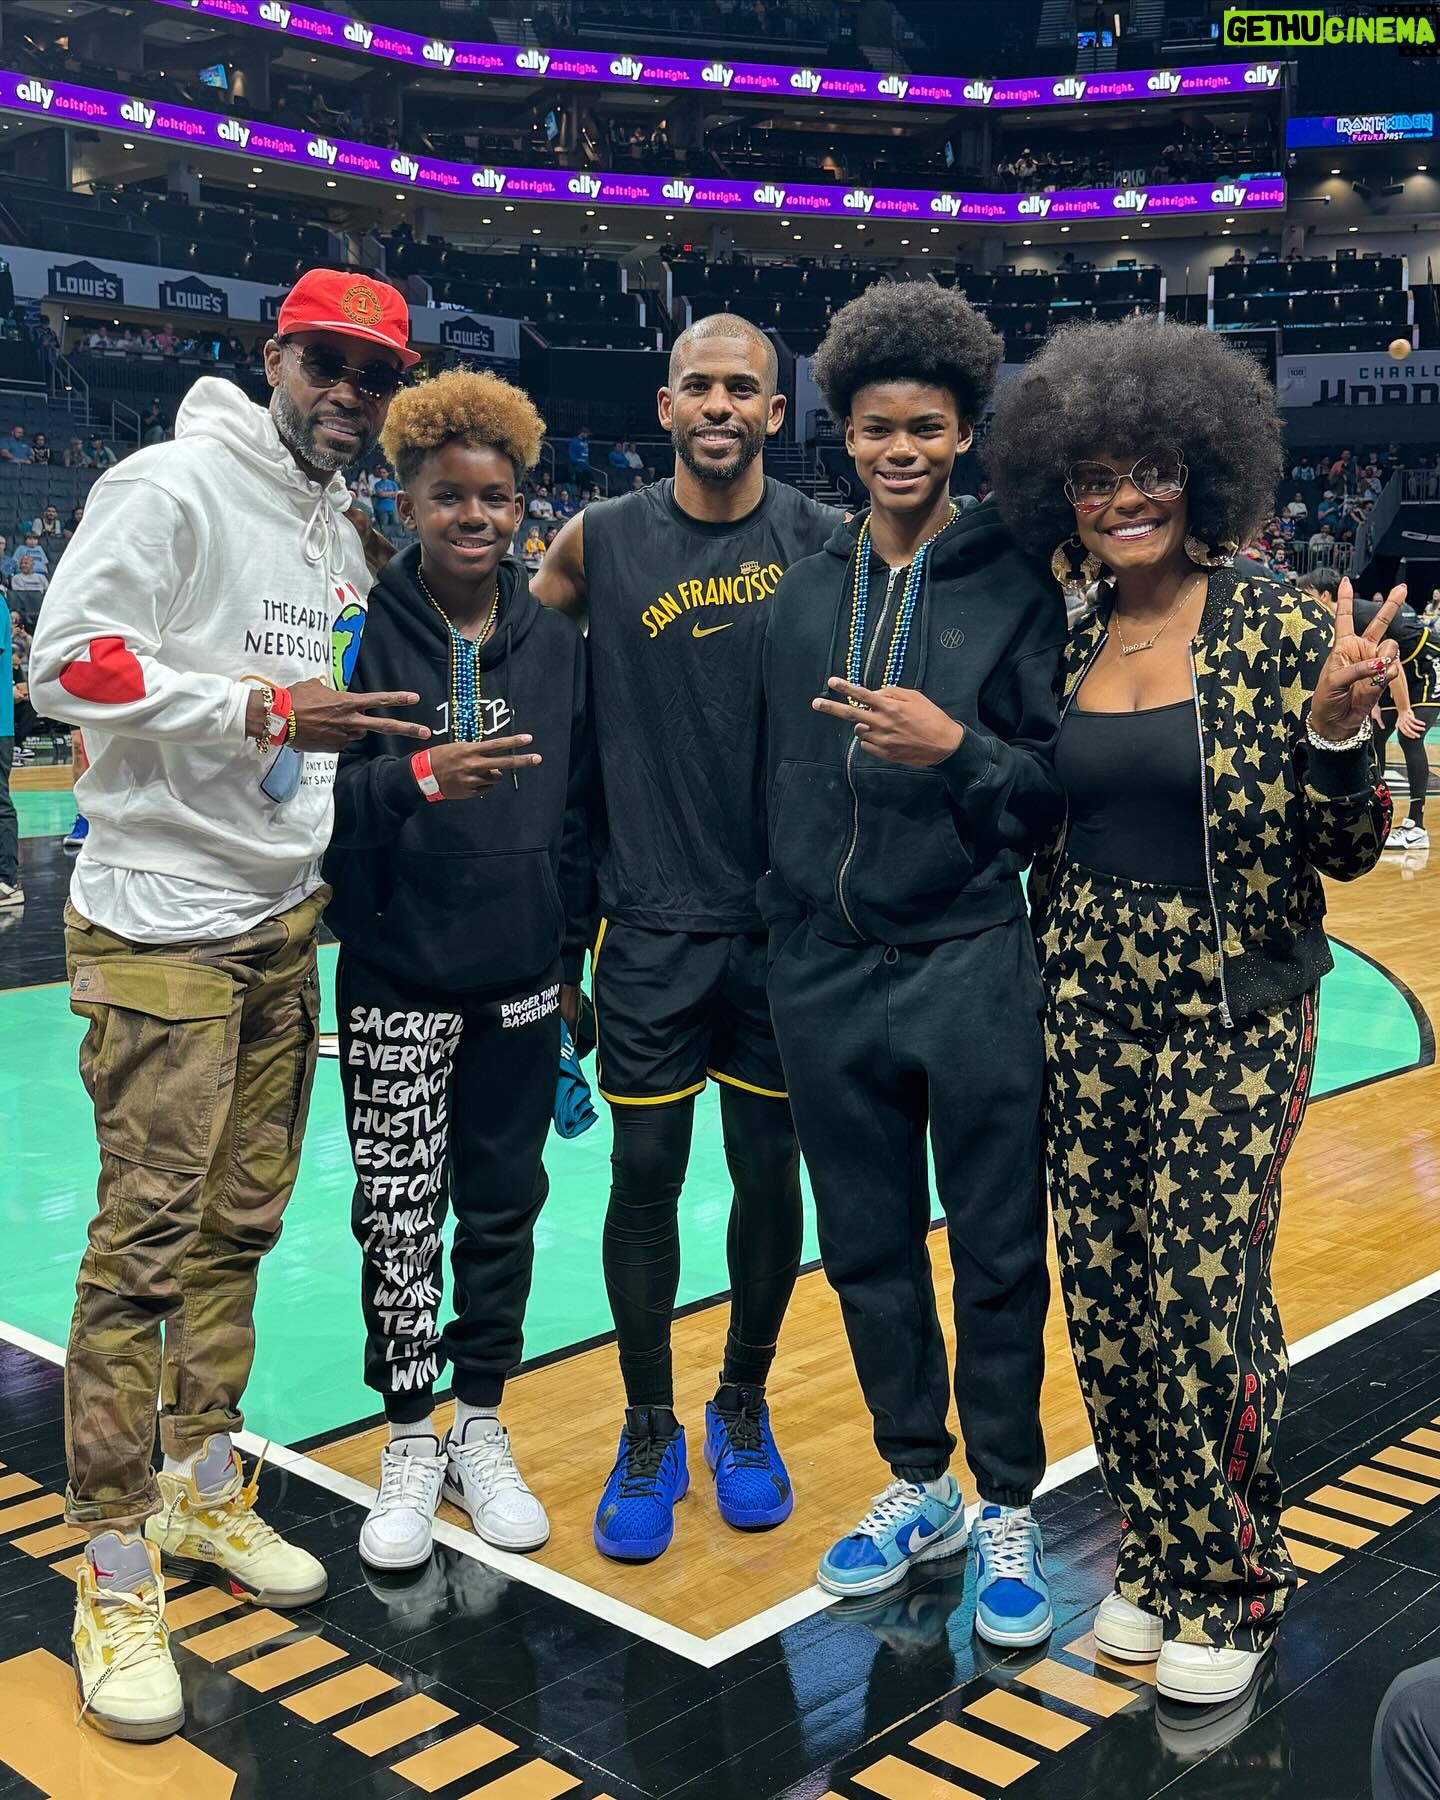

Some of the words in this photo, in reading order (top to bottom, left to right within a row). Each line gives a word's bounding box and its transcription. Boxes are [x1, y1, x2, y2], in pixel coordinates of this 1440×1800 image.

[260, 1, 290, 28] ally
[344, 22, 373, 48] ally
[423, 41, 454, 66] ally
[516, 50, 550, 73] ally
[610, 57, 642, 80] ally
[702, 64, 733, 87] ally
[791, 70, 821, 92] ally
[878, 76, 908, 98] ally
[964, 82, 993, 103] ally
[1053, 78, 1086, 99] ally
[1148, 72, 1181, 92] ally
[1244, 66, 1279, 86] ally
[1337, 117, 1374, 135] IRON
[1375, 113, 1434, 133] MAIDEN
[17, 81, 53, 109] ally
[121, 101, 155, 128] ally
[218, 120, 250, 147] ally
[308, 138, 337, 164] ally
[391, 156, 419, 180] ally
[472, 169, 506, 192] ally
[568, 175, 601, 198] ally
[662, 181, 694, 203] ally
[754, 186, 785, 207] ally
[843, 191, 874, 212] ally
[931, 195, 961, 216] ally
[1018, 196, 1051, 216] ally
[1113, 191, 1147, 211] ally
[1211, 185, 1246, 205] ally
[55, 271, 118, 300] LOWE'S
[165, 286, 224, 314] LOWE'S
[445, 325, 490, 348] LOWE'S
[641, 591, 683, 639] SAN
[677, 562, 784, 612] FRANCISCO
[501, 994, 540, 1018] BIGGER
[540, 983, 560, 1004] THAN
[502, 996, 560, 1029] BASKETBALL
[352, 1093, 447, 1138] HUSTLE
[373, 1272, 442, 1309] WORK
[378, 1309, 438, 1339] TEA
[391, 1351, 439, 1392] WIN
[1227, 1373, 1258, 1483] PALM
